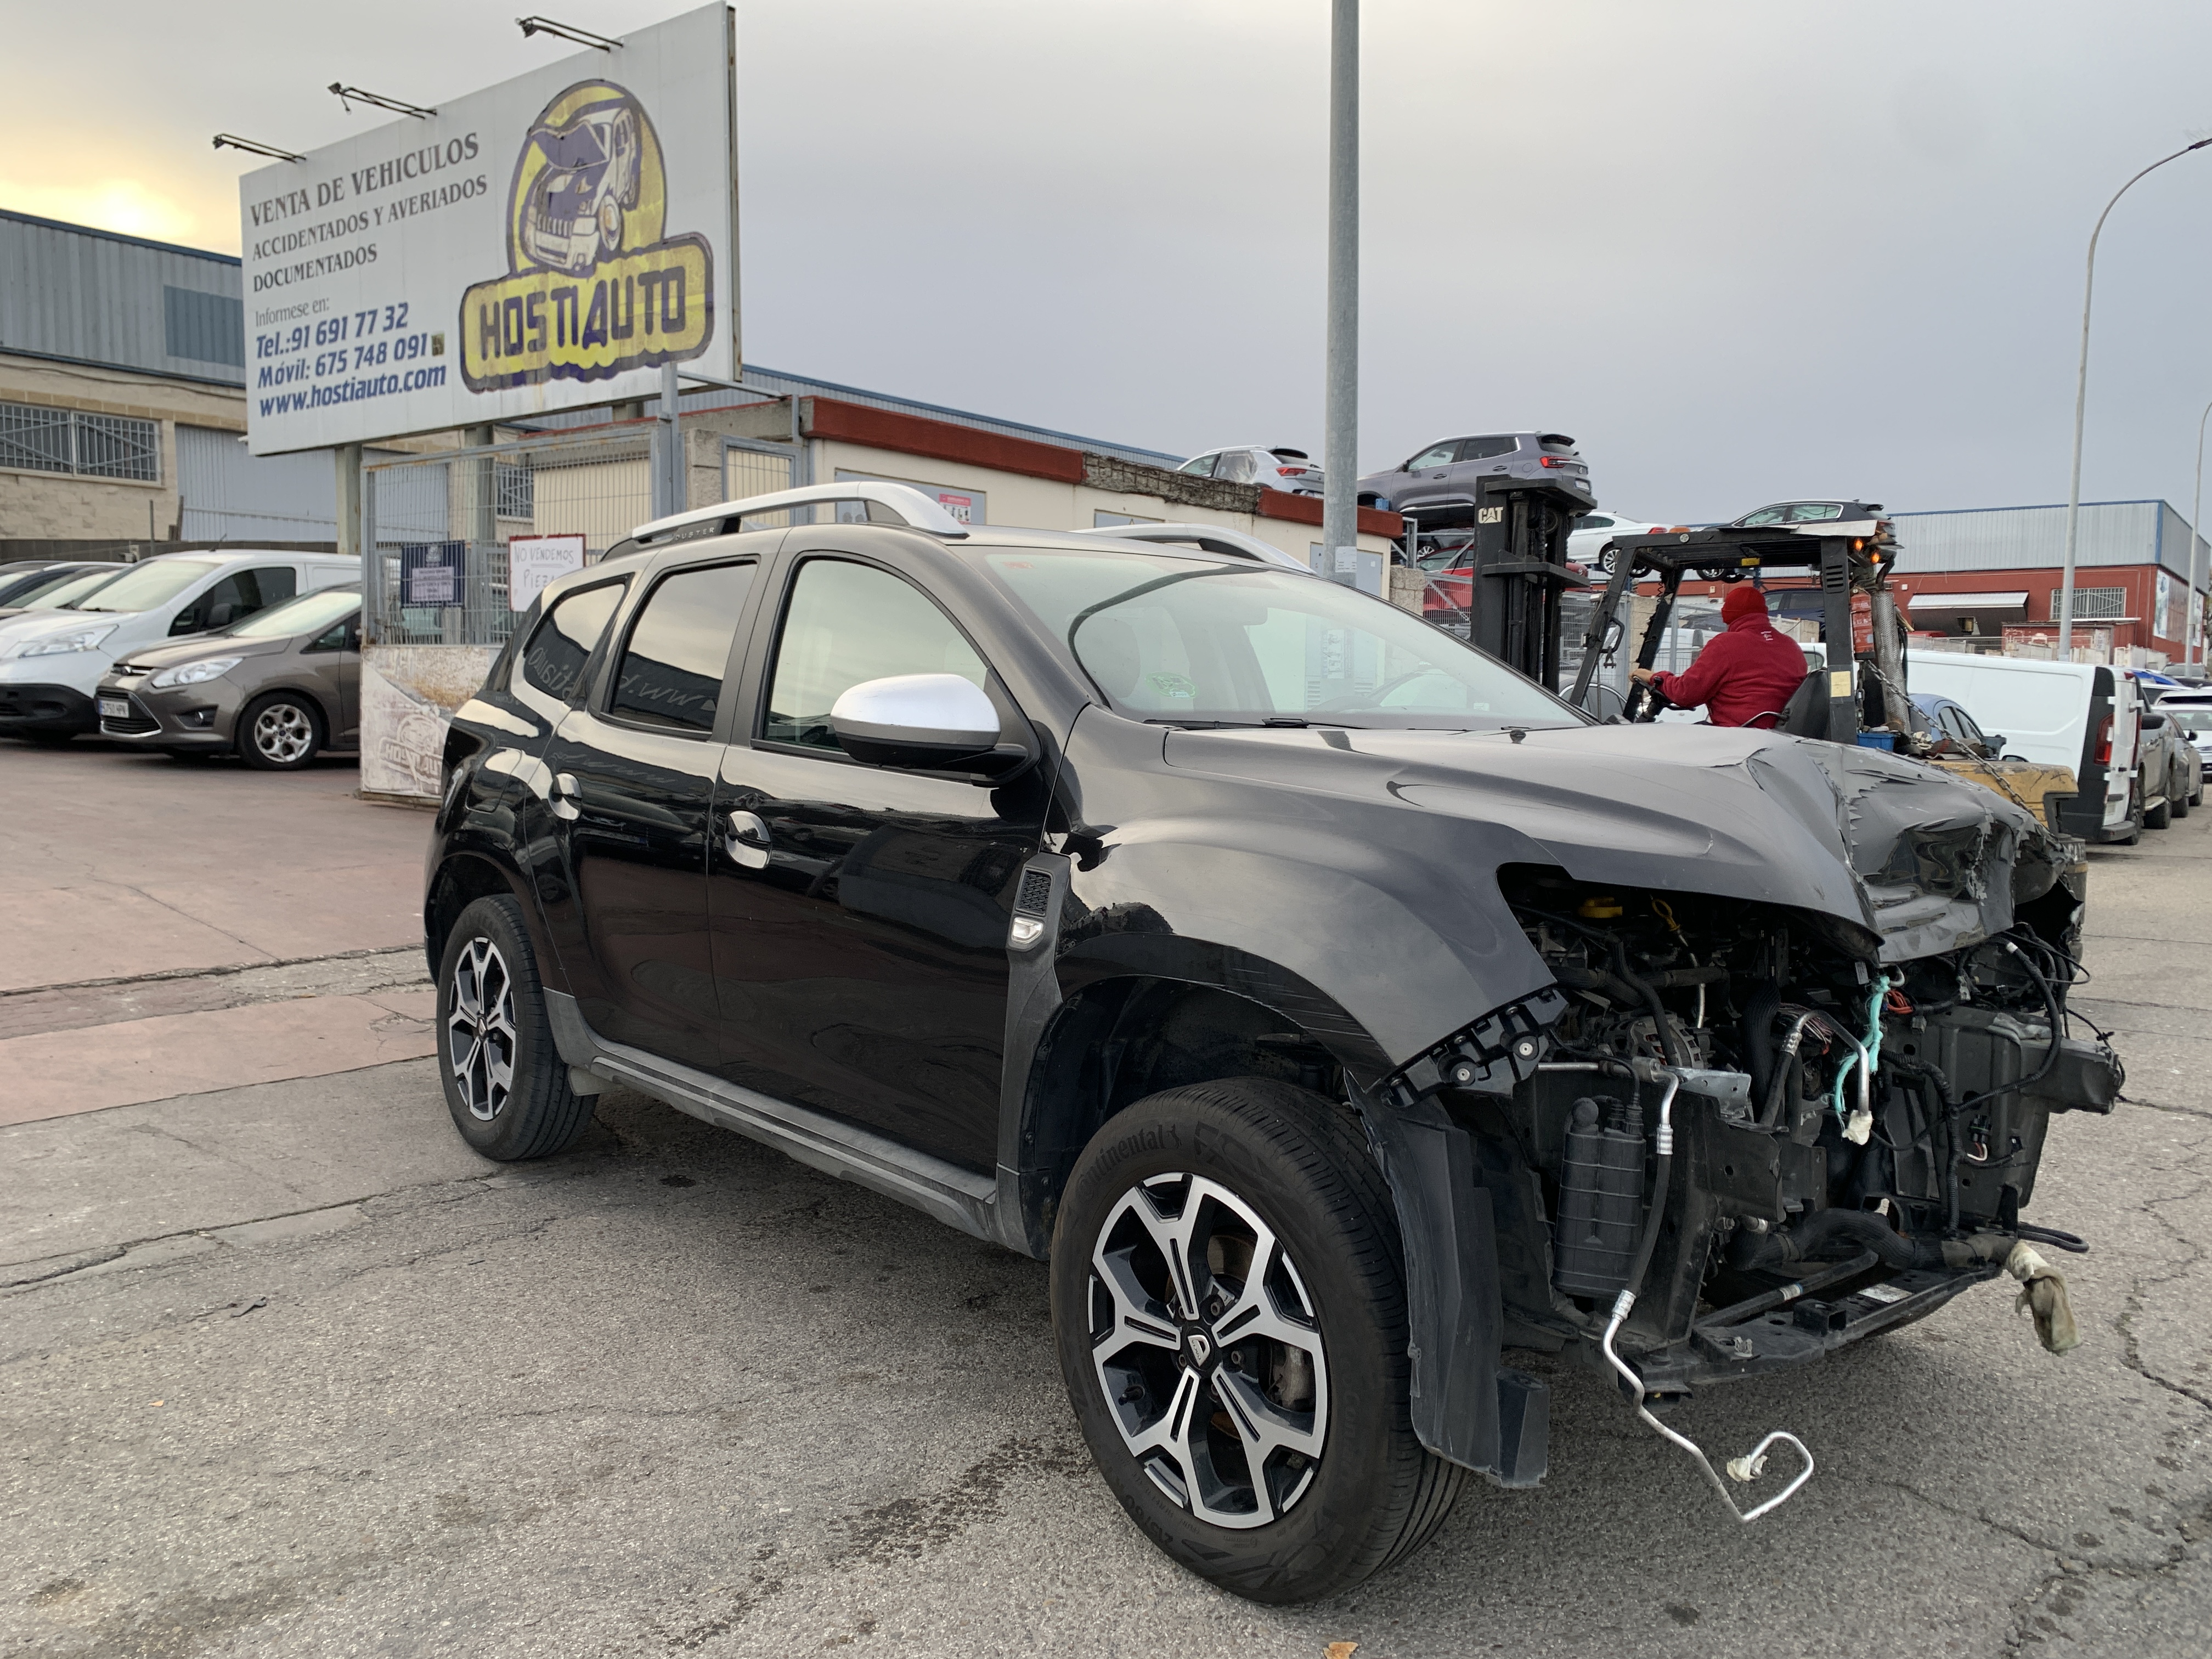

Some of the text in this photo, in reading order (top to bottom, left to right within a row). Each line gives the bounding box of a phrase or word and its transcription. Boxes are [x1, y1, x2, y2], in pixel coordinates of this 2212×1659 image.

[250, 131, 479, 227] VENTA DE VEHICULOS
[252, 174, 488, 262] ACCIDENTADOS Y AVERIADOS
[253, 242, 378, 293] DOCUMENTADOS
[255, 297, 330, 328] Informese en:
[315, 315, 348, 346] 691
[355, 308, 379, 338] 77
[382, 302, 409, 332] 32
[479, 266, 686, 362] HOSTIAUTO
[257, 332, 428, 389] Móvil: 675 748 091
[259, 364, 447, 417] www.hostiauto.com
[1478, 506, 1504, 524] CAT
[514, 545, 574, 565] NO VENDEMOS
